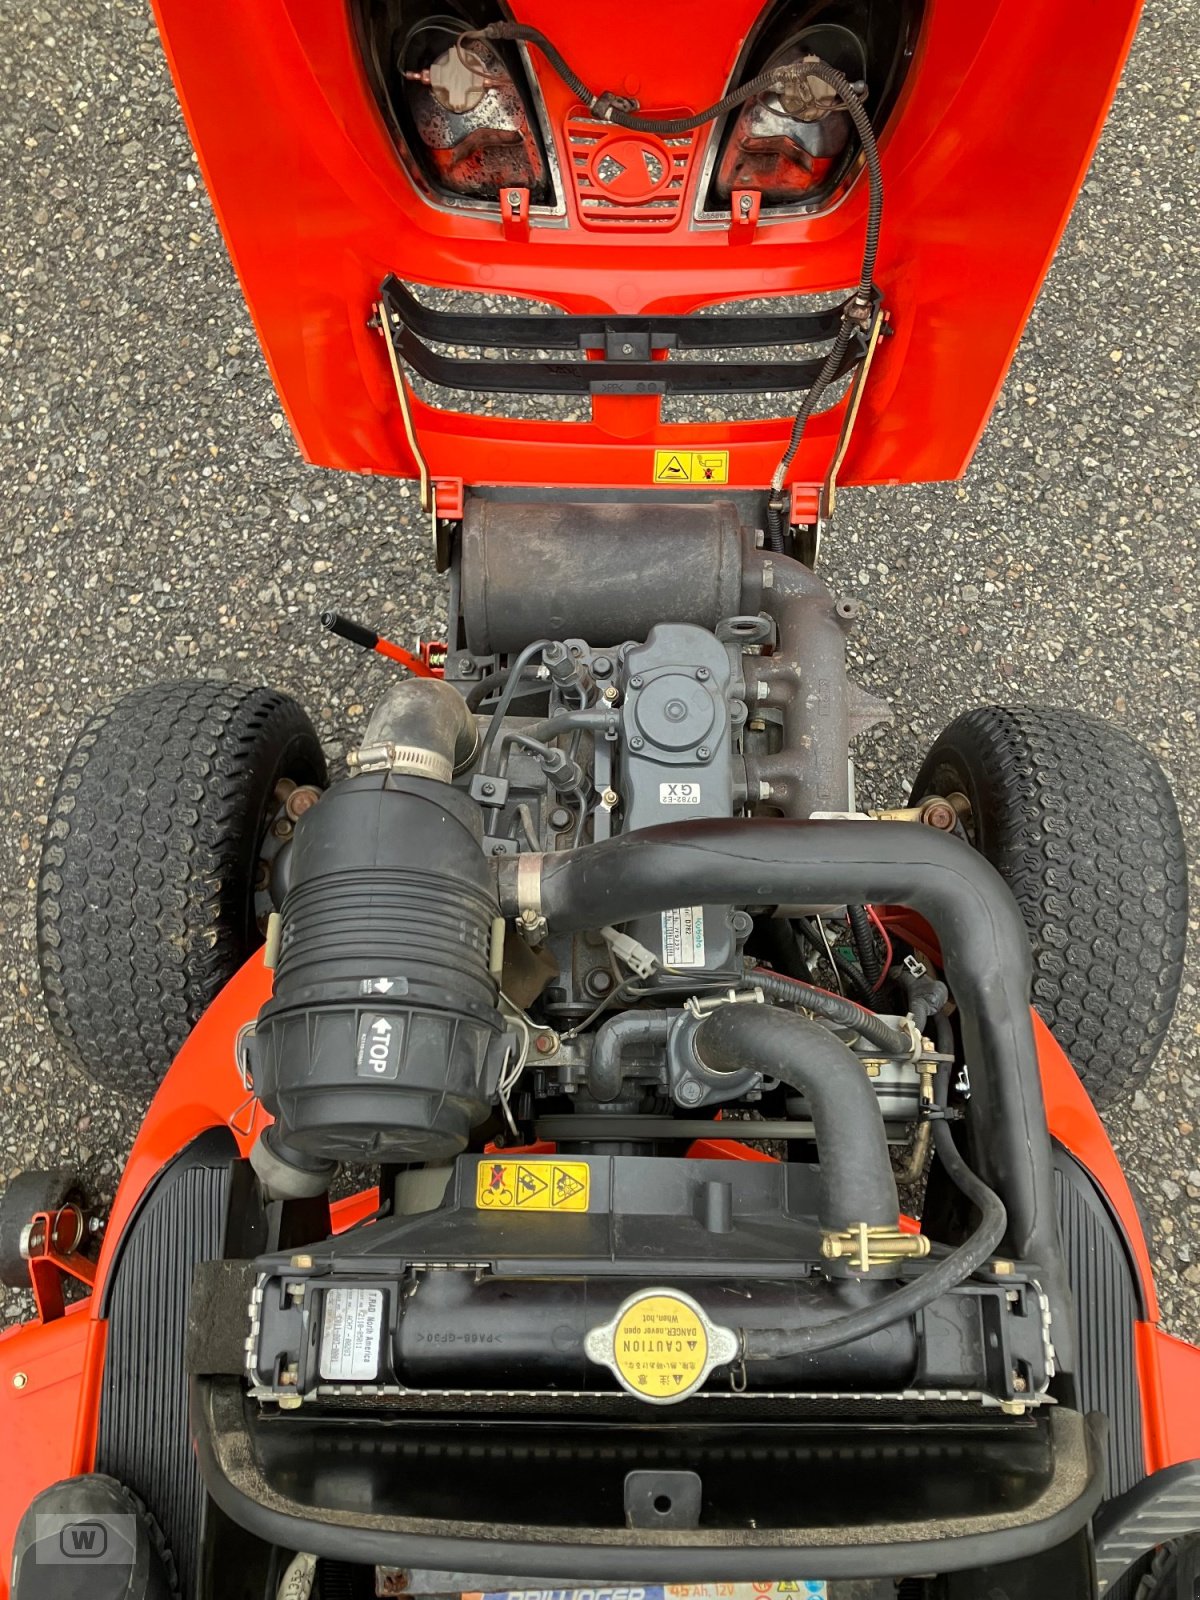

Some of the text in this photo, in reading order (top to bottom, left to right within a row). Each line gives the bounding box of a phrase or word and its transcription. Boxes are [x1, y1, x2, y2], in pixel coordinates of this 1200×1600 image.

[668, 784, 692, 796] GX
[695, 917, 703, 949] Kubota
[368, 1033, 391, 1073] TOP
[363, 1293, 377, 1363] T.RAD North America
[624, 1326, 641, 1335] open
[623, 1340, 682, 1352] CAUTION
[670, 1583, 689, 1597] 45
[715, 1582, 735, 1597] 12V
